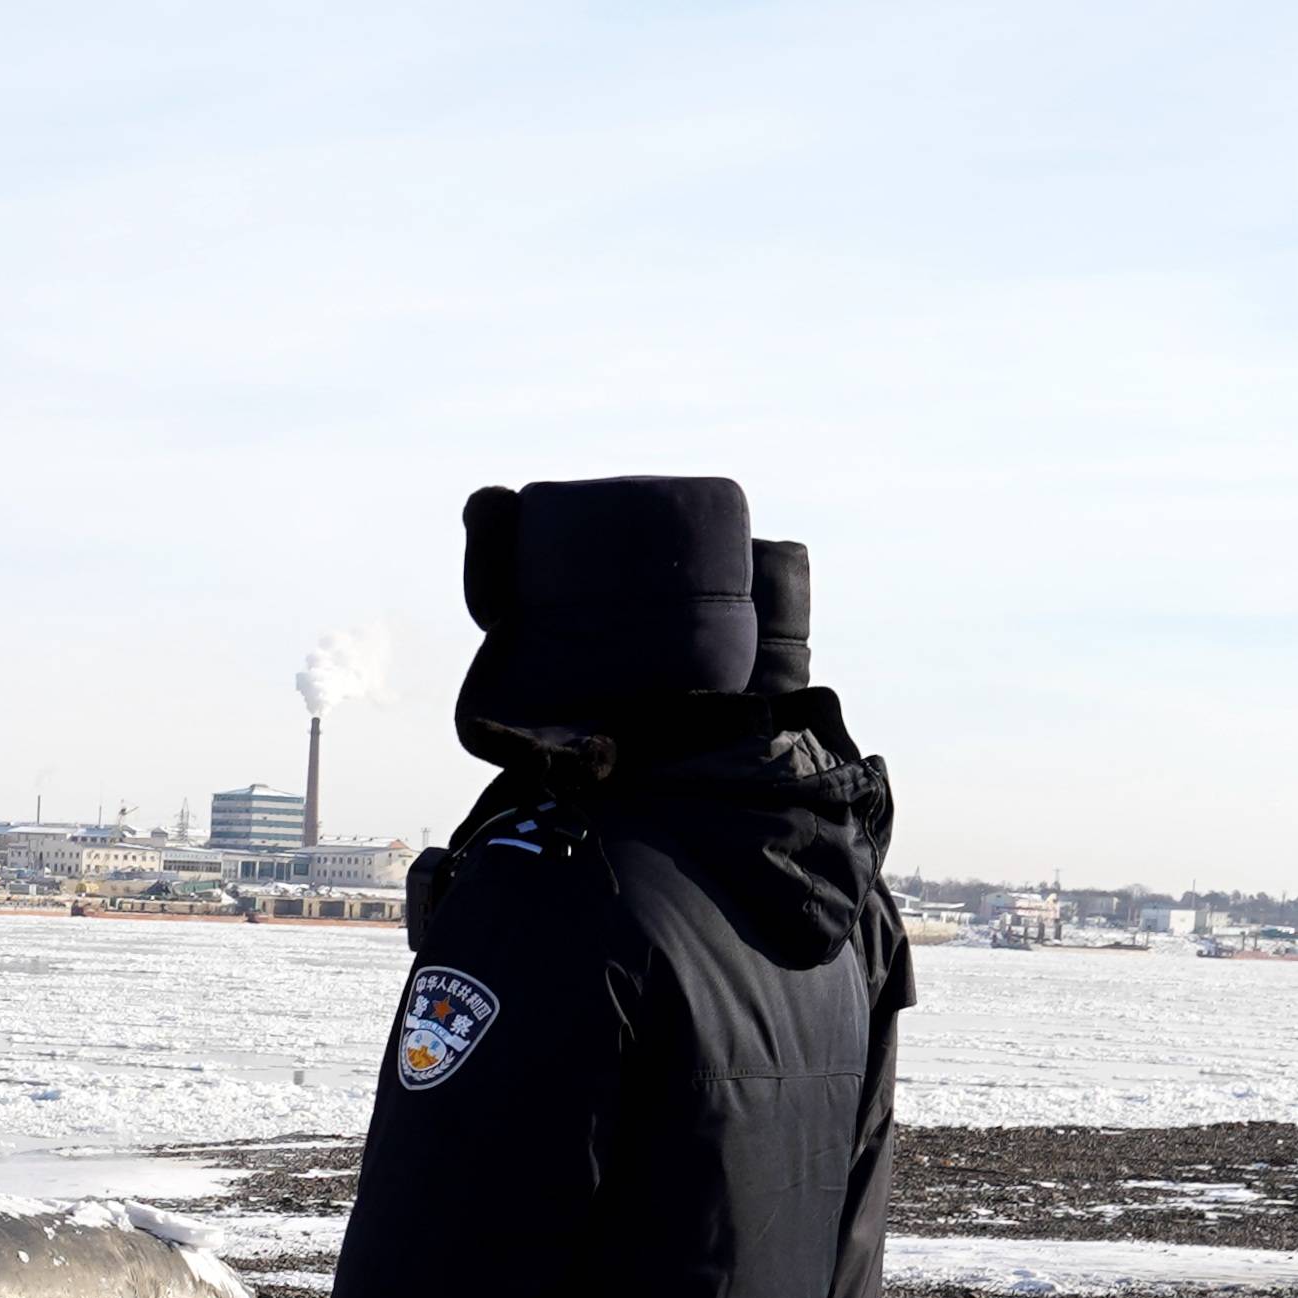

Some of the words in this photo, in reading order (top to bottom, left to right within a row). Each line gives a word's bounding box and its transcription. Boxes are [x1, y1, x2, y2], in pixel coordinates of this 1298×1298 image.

[416, 975, 492, 1021] 中华人民共和国
